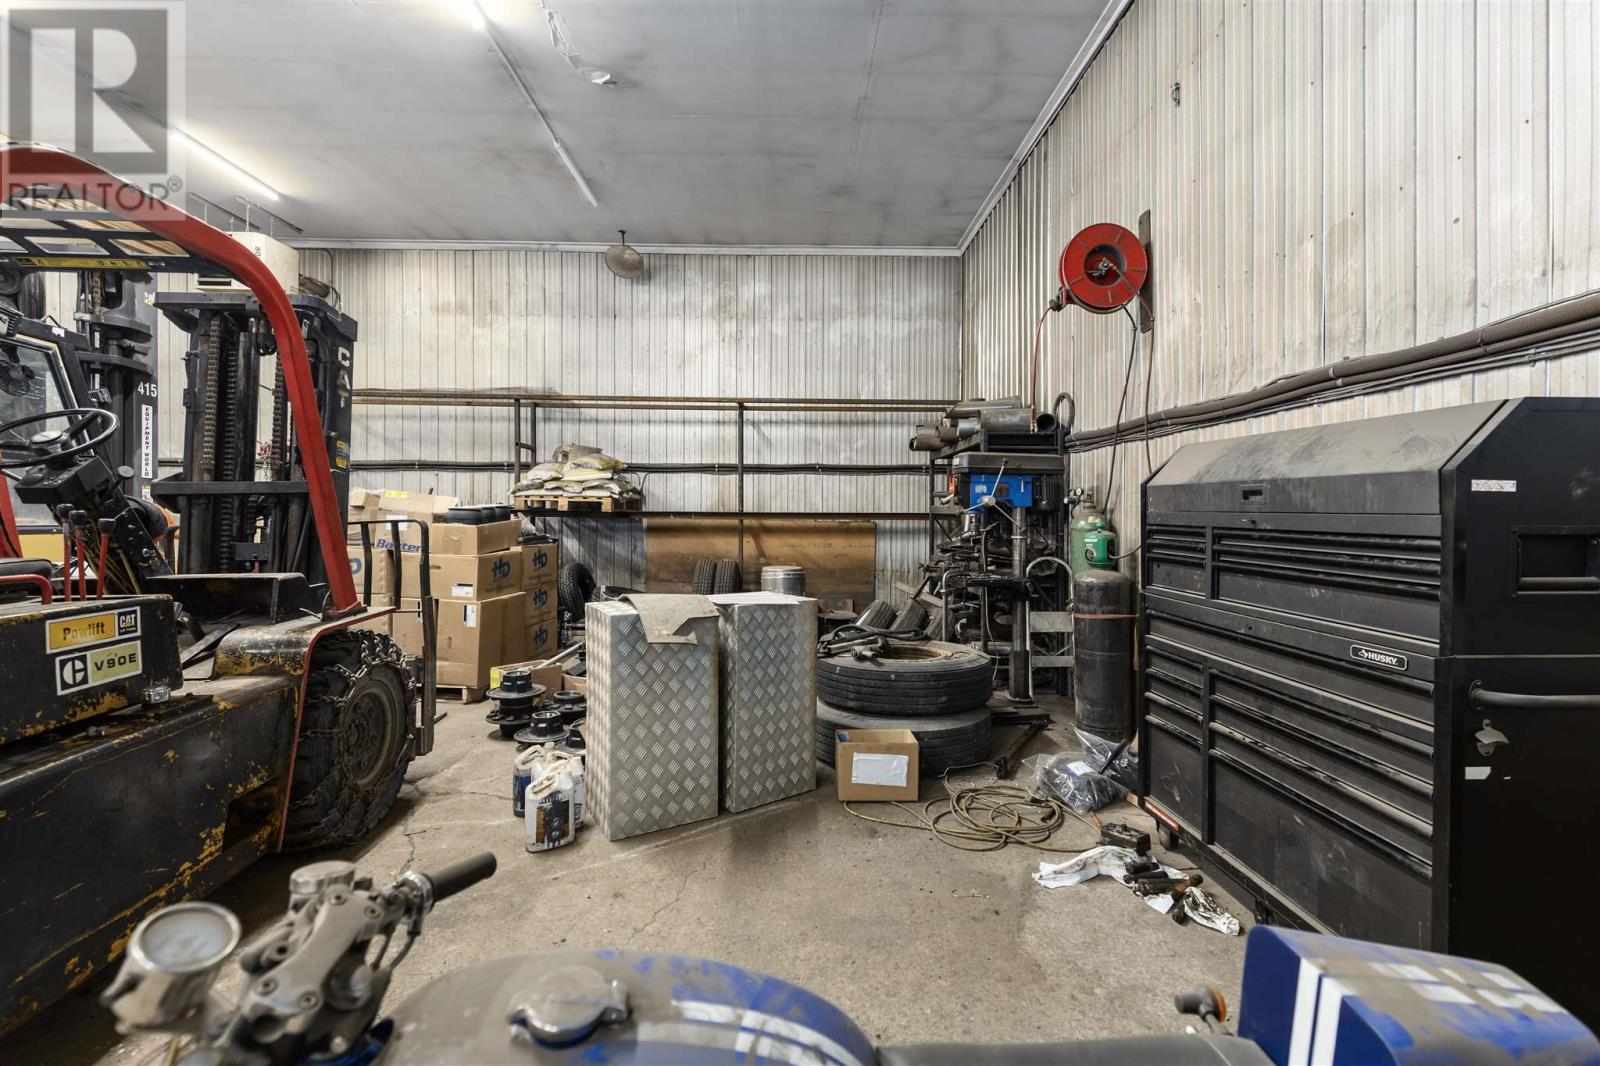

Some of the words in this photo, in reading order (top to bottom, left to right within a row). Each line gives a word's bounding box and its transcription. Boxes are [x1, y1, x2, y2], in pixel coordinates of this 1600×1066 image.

[138, 381, 157, 398] 415
[376, 538, 421, 552] Bater
[62, 621, 105, 641] Powlift
[119, 614, 136, 628] CAT
[94, 653, 137, 671] V90E
[1368, 652, 1398, 665] HUSKY
